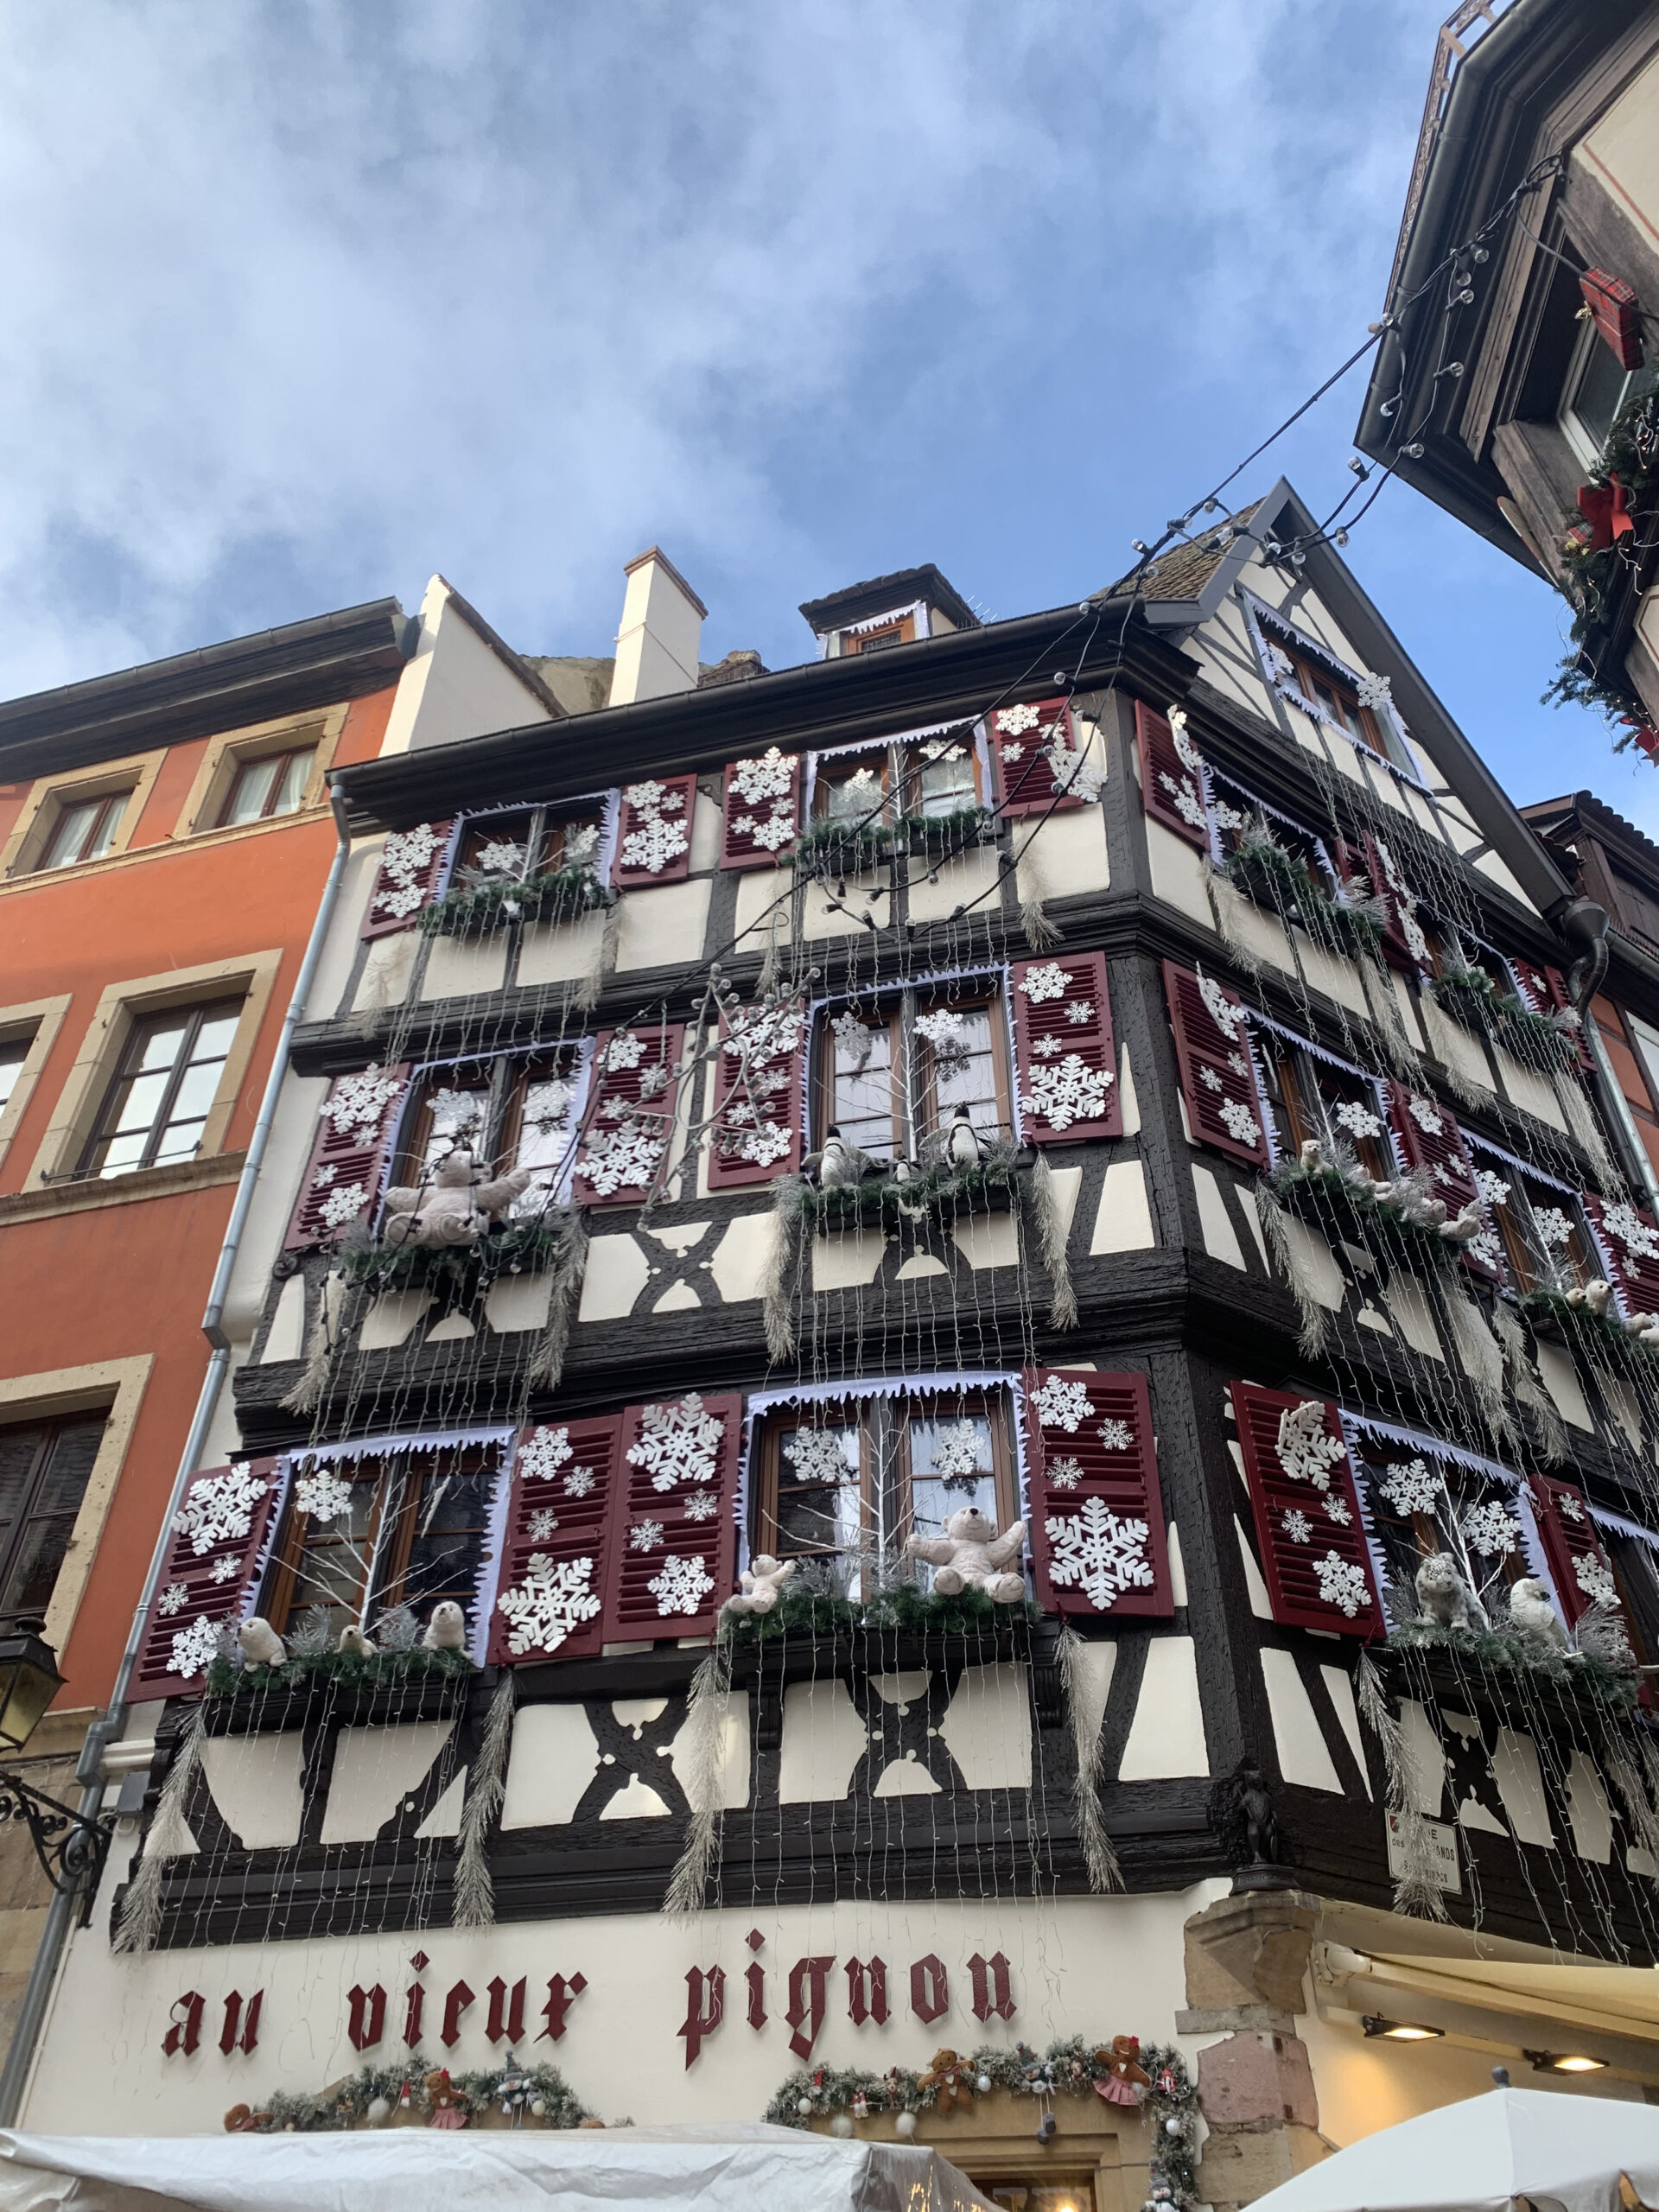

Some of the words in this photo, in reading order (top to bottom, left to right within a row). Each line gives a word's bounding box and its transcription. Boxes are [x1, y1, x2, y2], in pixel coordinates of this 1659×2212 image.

[1391, 1837, 1405, 1848] des
[162, 1989, 264, 2057] au
[346, 1949, 588, 2049] vieux
[677, 1928, 1017, 2071] pignon
